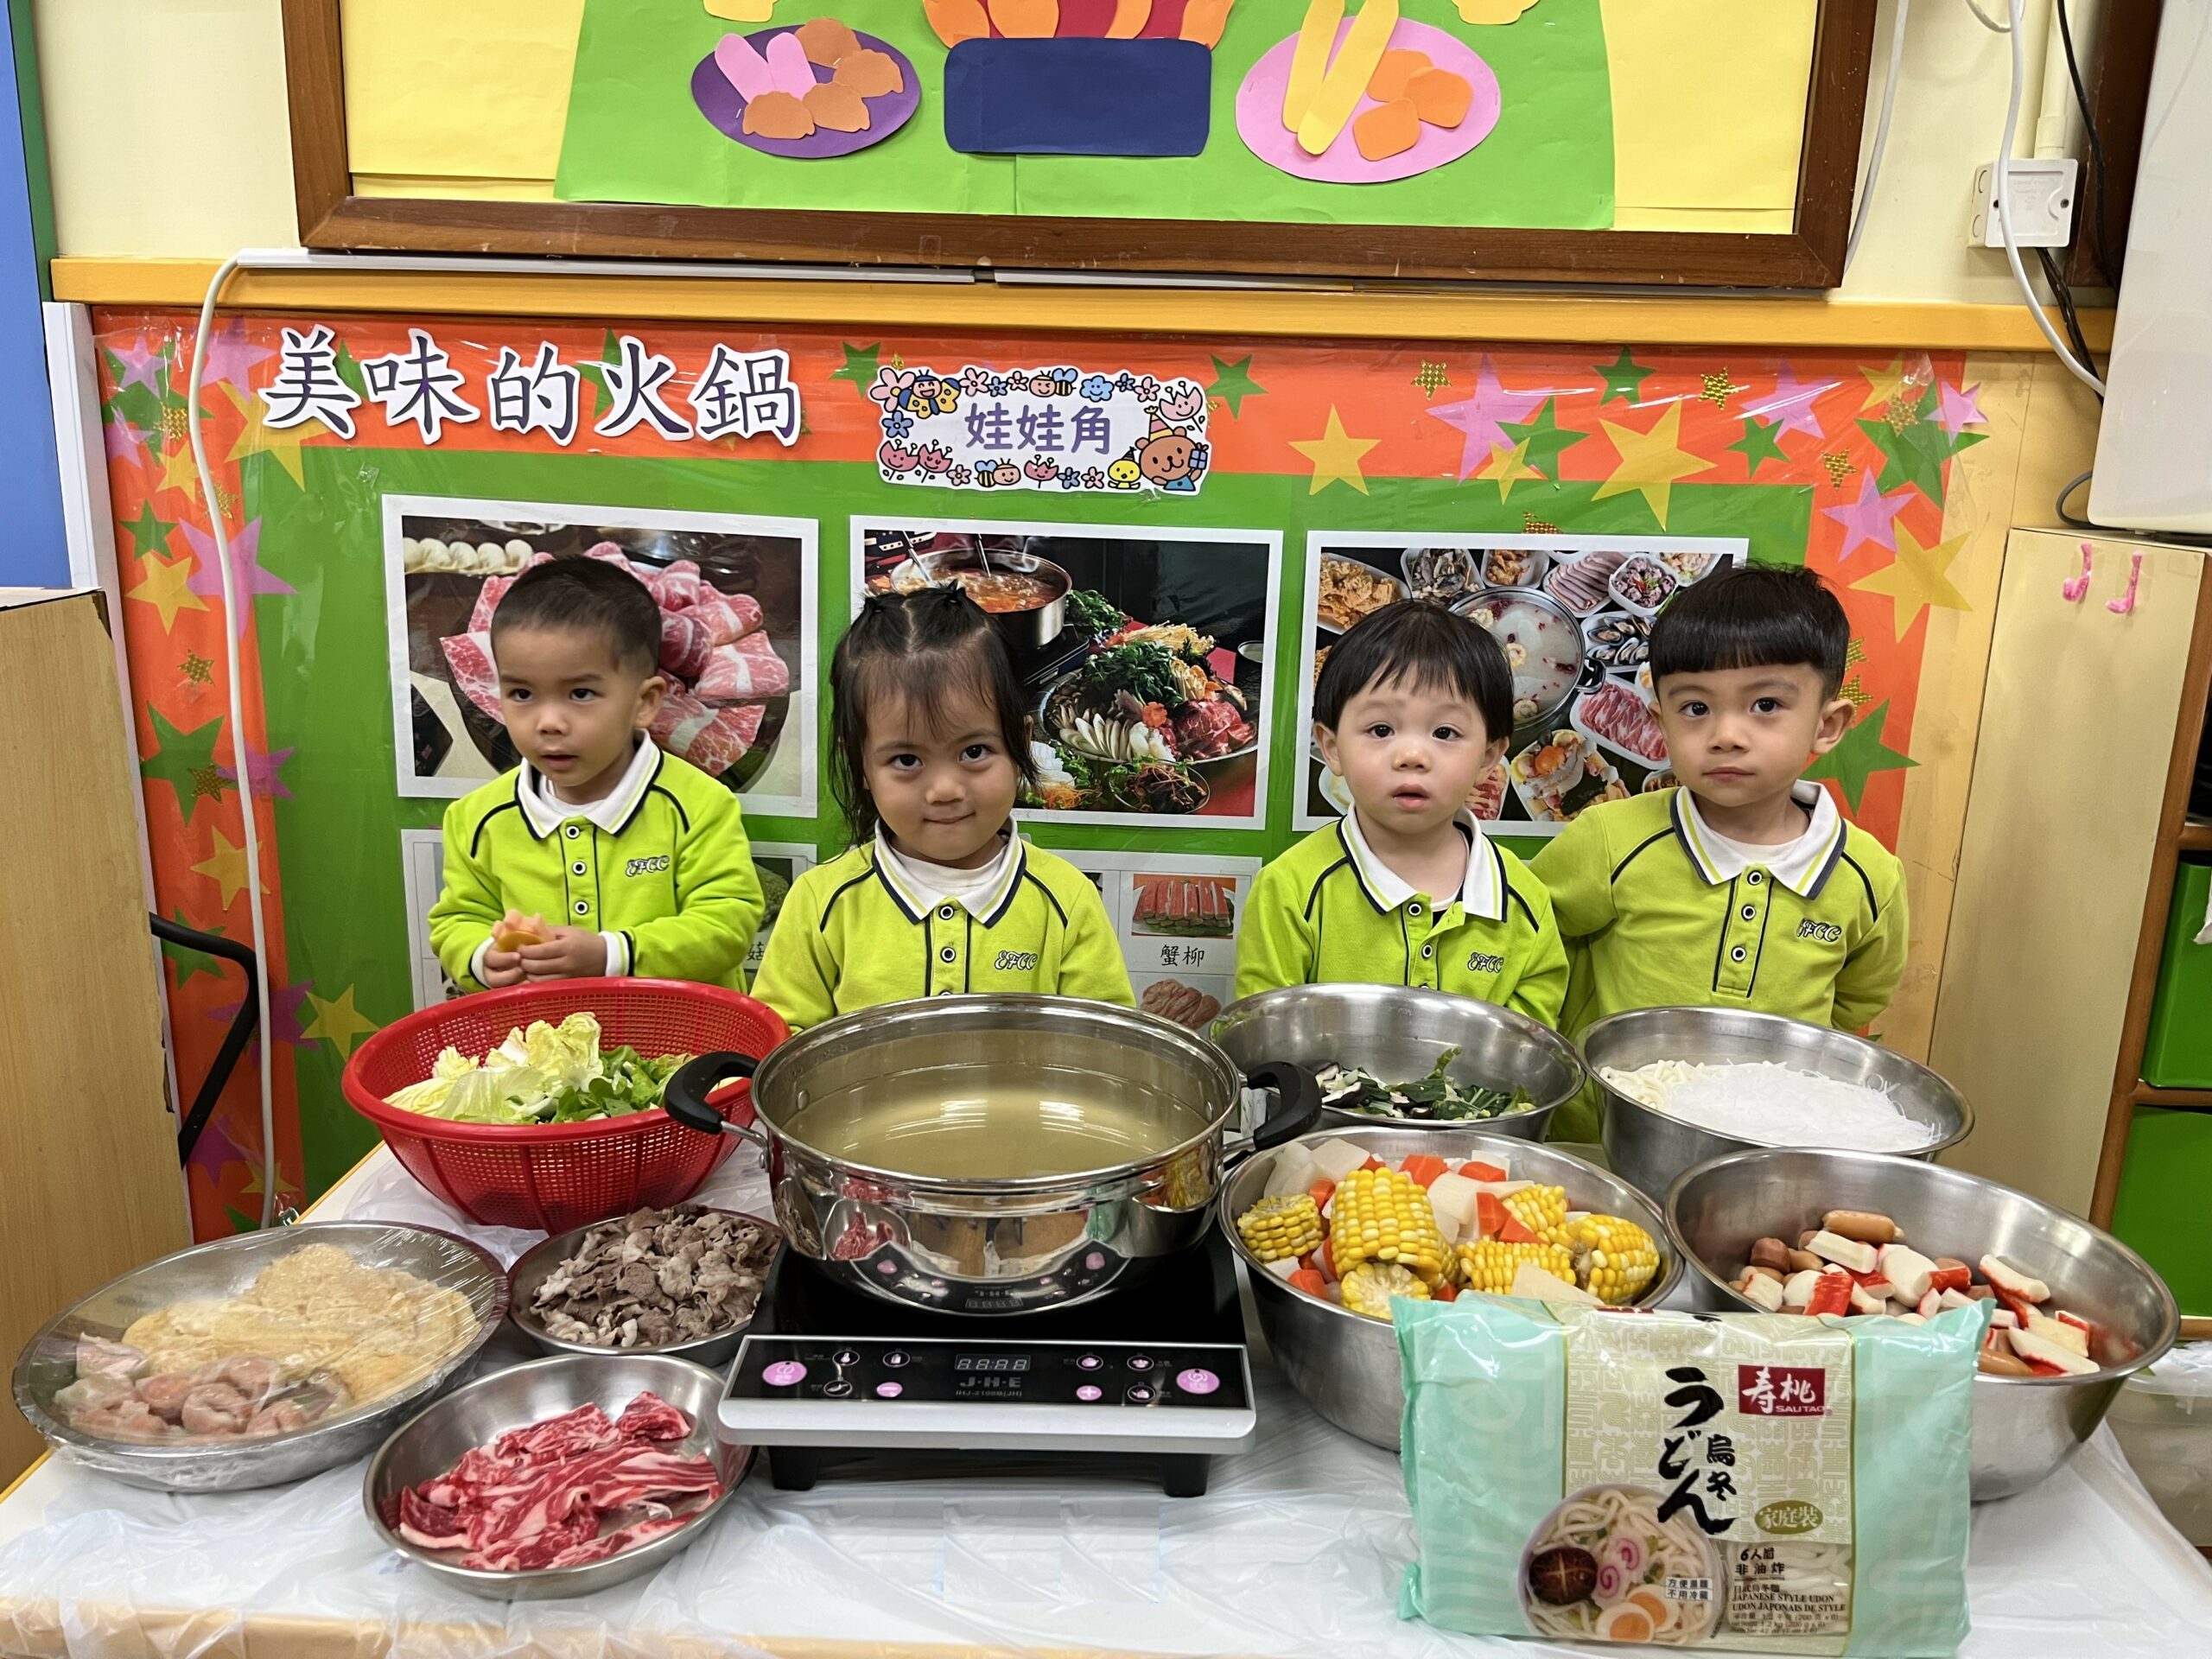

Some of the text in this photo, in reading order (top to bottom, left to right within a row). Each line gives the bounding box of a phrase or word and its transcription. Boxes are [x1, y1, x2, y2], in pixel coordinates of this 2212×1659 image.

[264, 329, 798, 441] 美味的火鍋
[964, 402, 1111, 454] 娃娃角
[1160, 944, 1205, 967] 蟹柳
[1656, 1366, 1739, 1535] うどん
[1732, 1592, 1776, 1602] JAPANESE
[1778, 1594, 1808, 1603] STYLE
[1732, 1603, 1758, 1611] UDON
[1758, 1602, 1802, 1611] JAPONAIS
